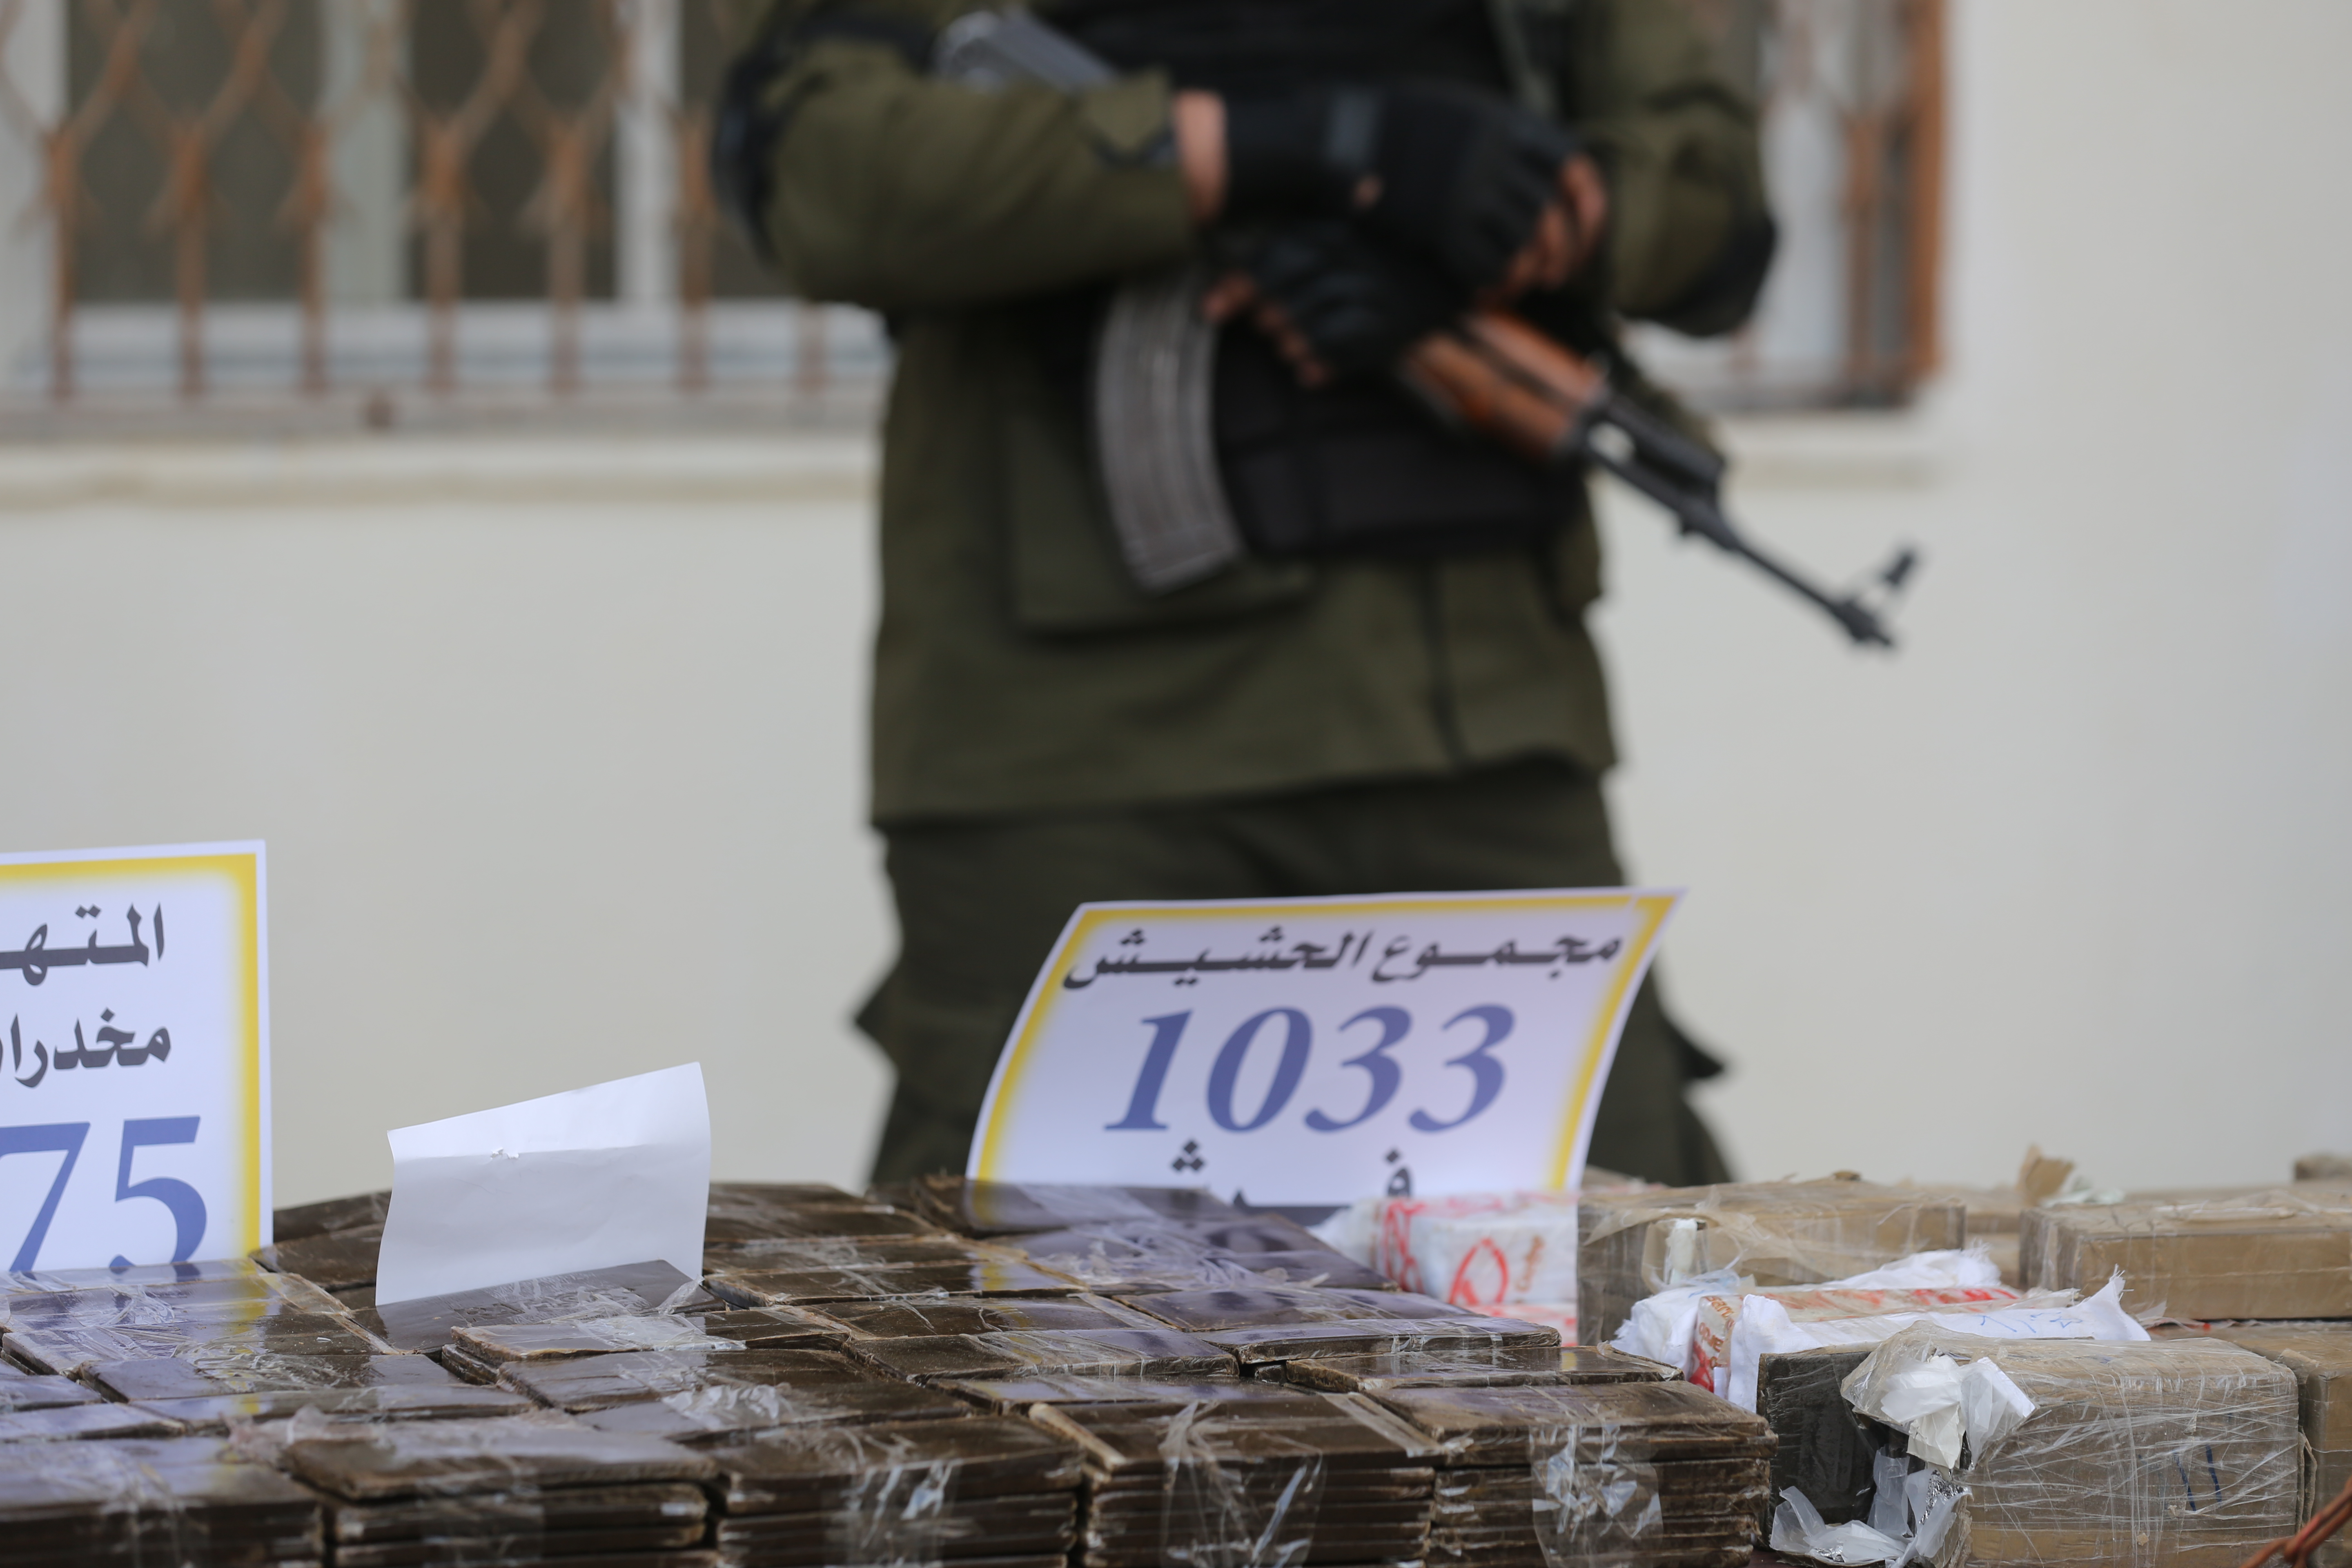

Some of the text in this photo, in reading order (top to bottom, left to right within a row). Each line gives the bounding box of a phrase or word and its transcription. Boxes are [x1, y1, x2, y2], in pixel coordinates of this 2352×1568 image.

[0, 902, 164, 986] المته
[1062, 926, 1623, 989] مجموع الحشيش
[0, 1007, 171, 1088] مخدرا
[1102, 1005, 1516, 1134] 1033
